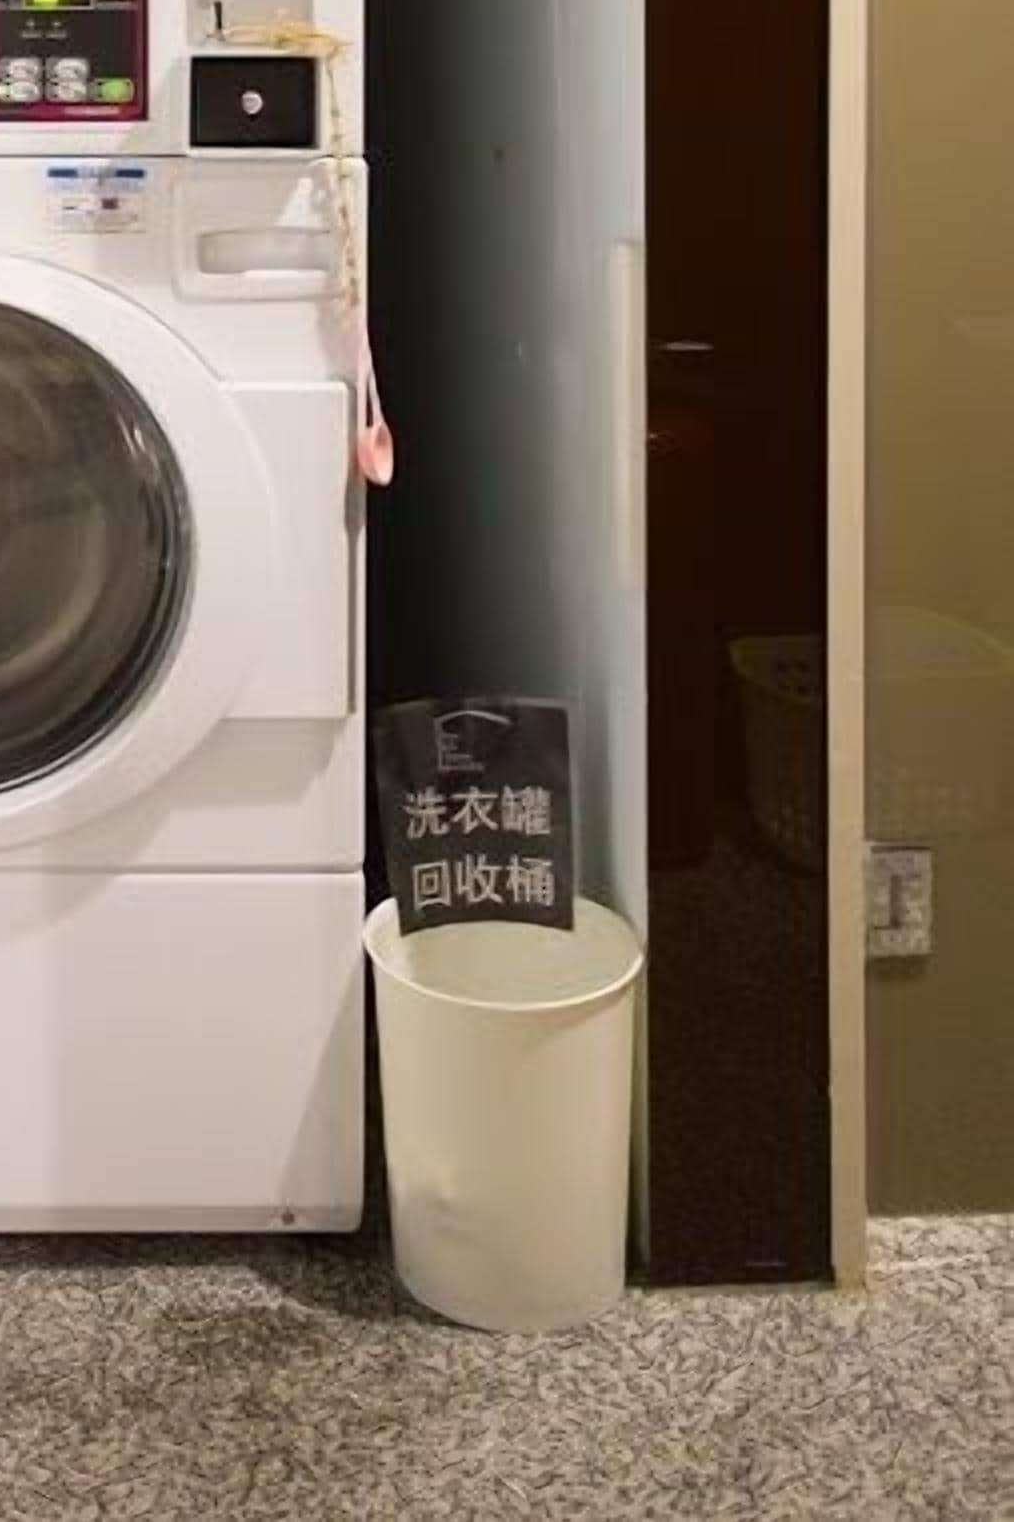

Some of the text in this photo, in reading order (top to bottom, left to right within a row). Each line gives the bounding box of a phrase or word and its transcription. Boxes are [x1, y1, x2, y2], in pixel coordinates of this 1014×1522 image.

[404, 786, 551, 838] 洗衣罐
[412, 854, 555, 909] 回收桶
